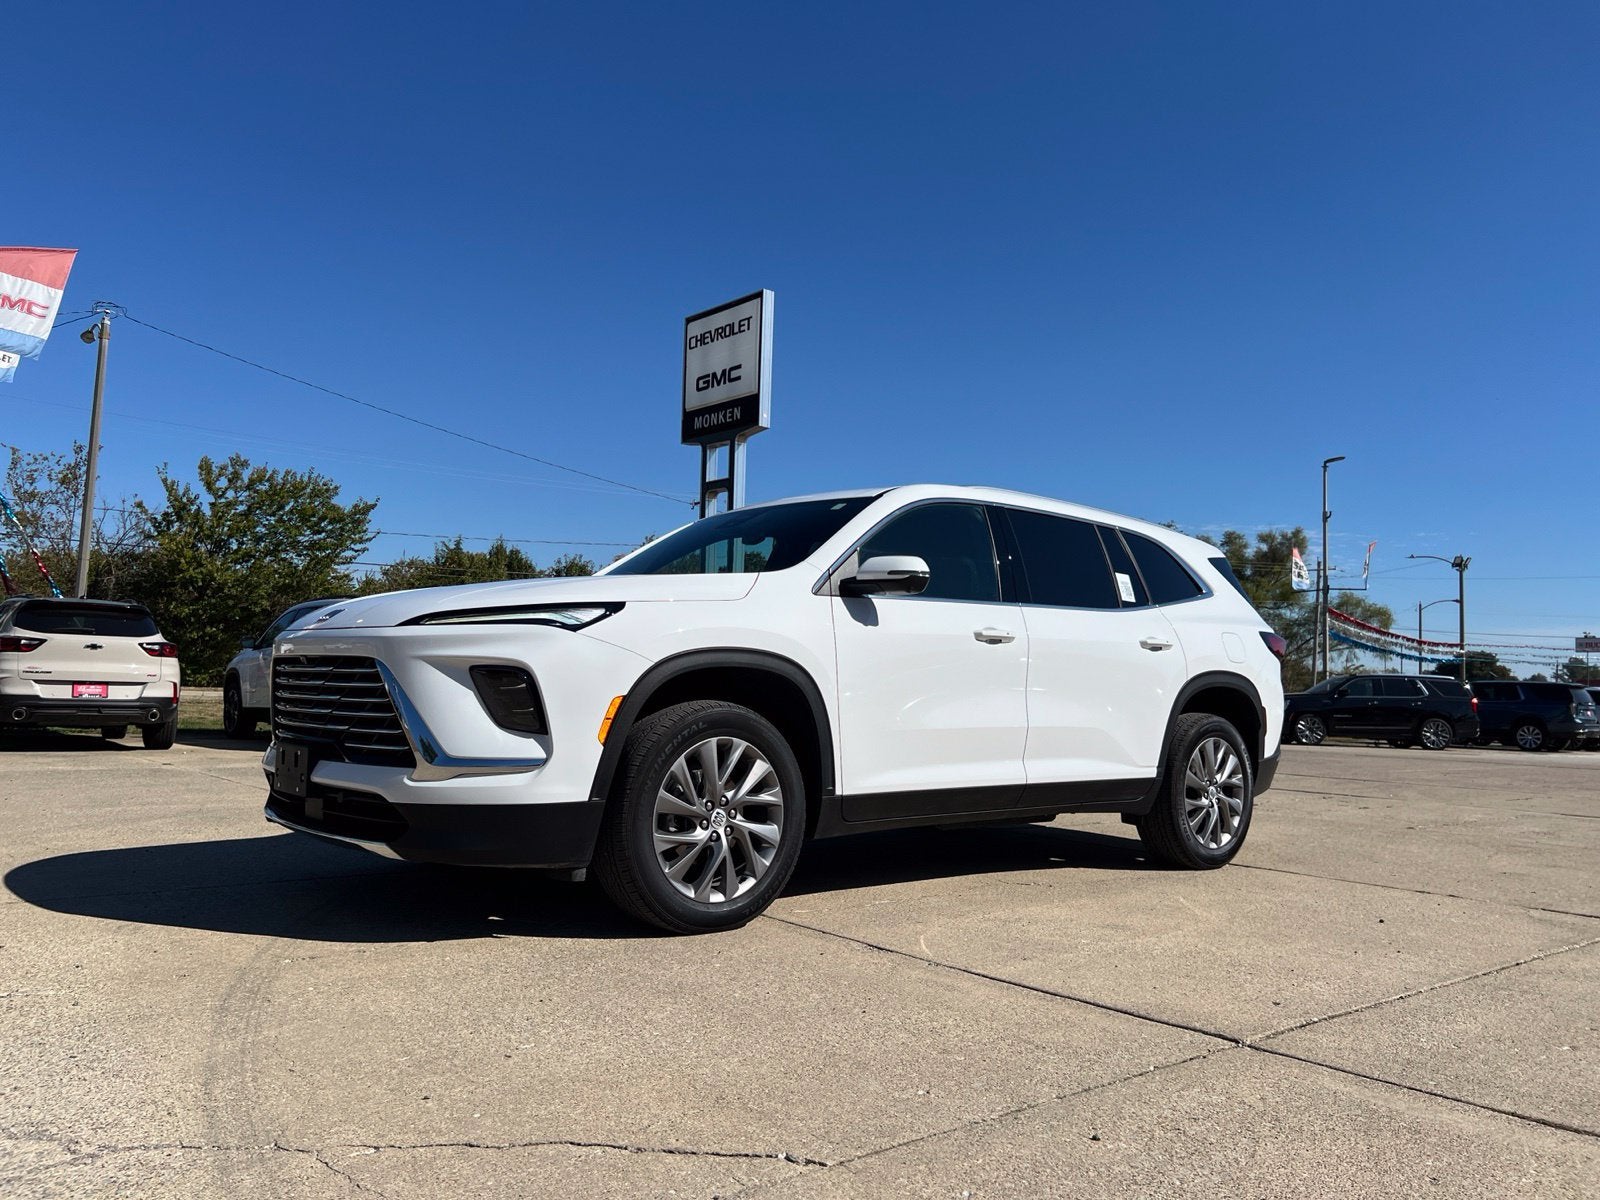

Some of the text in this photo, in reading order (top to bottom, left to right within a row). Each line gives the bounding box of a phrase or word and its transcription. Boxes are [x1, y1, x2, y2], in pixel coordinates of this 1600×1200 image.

[0, 294, 49, 319] MC
[688, 316, 753, 350] CHEVROLET
[696, 363, 742, 392] GMC
[694, 406, 741, 430] MONKEN
[642, 721, 708, 806] NTINENTAL
